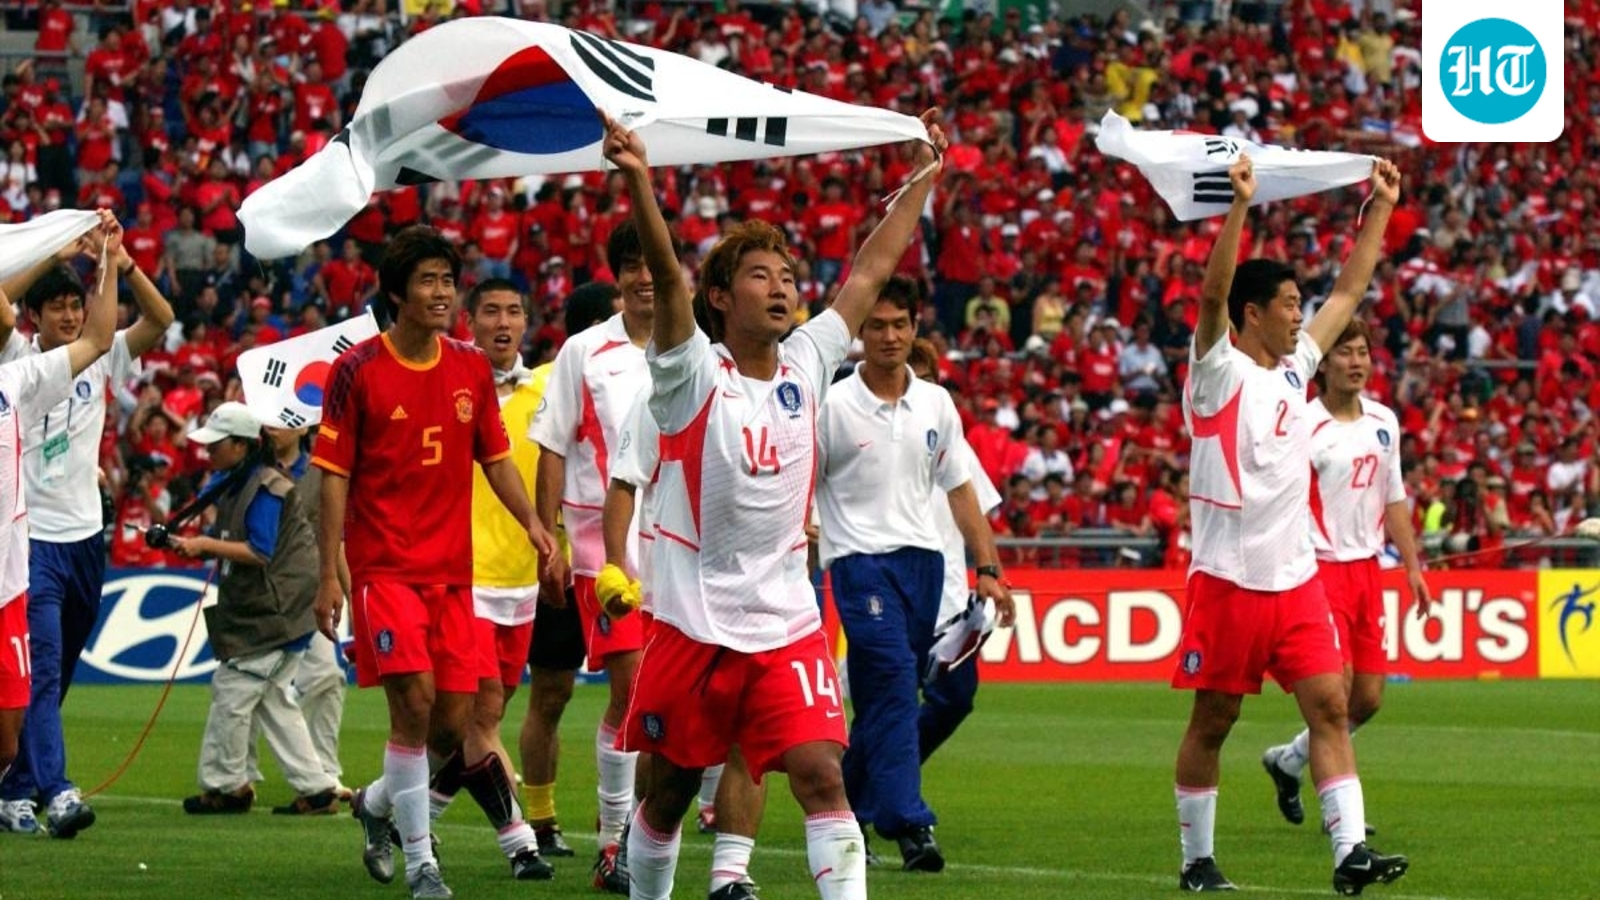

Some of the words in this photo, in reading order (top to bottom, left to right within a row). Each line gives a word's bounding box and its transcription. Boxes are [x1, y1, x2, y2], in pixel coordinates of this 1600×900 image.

[1275, 399, 1288, 437] 2
[422, 425, 442, 466] 5
[742, 426, 781, 476] 14
[790, 658, 839, 707] 14
